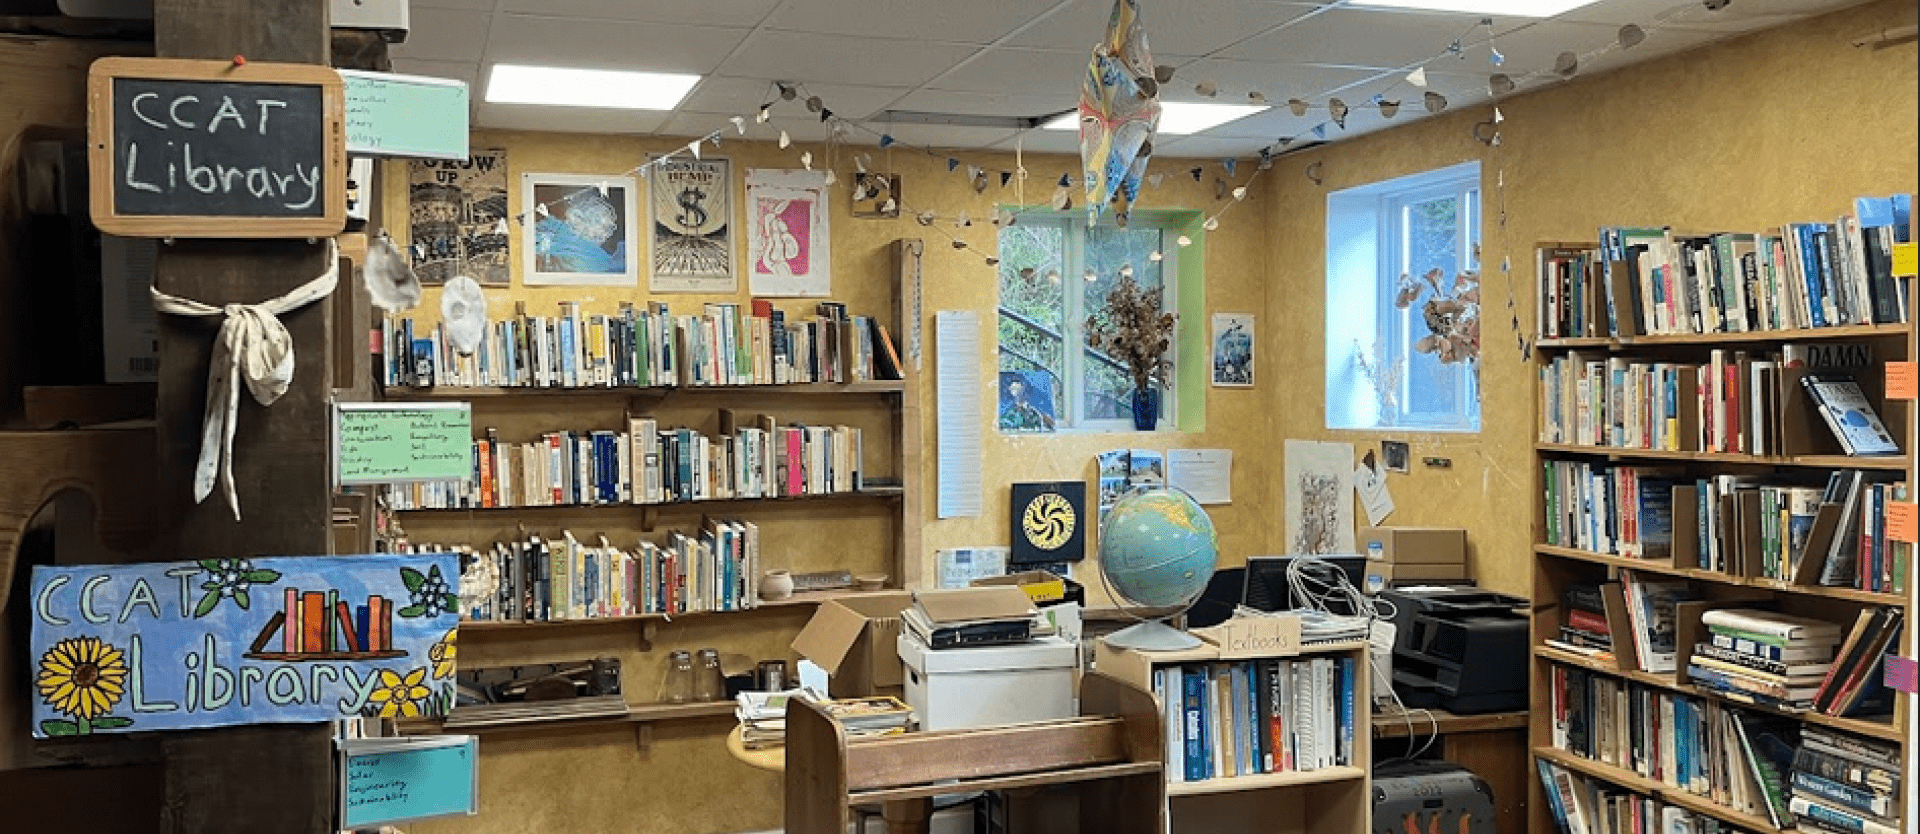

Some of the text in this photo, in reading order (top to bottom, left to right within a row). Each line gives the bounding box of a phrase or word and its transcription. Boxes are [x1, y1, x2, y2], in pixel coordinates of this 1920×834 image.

[131, 92, 287, 135] CCAT
[125, 140, 320, 210] Library
[435, 170, 459, 183] UP
[1807, 343, 1869, 368] DAMN
[36, 566, 203, 626] CCAT
[1222, 622, 1289, 653] Textbooks
[131, 633, 382, 714] Library
